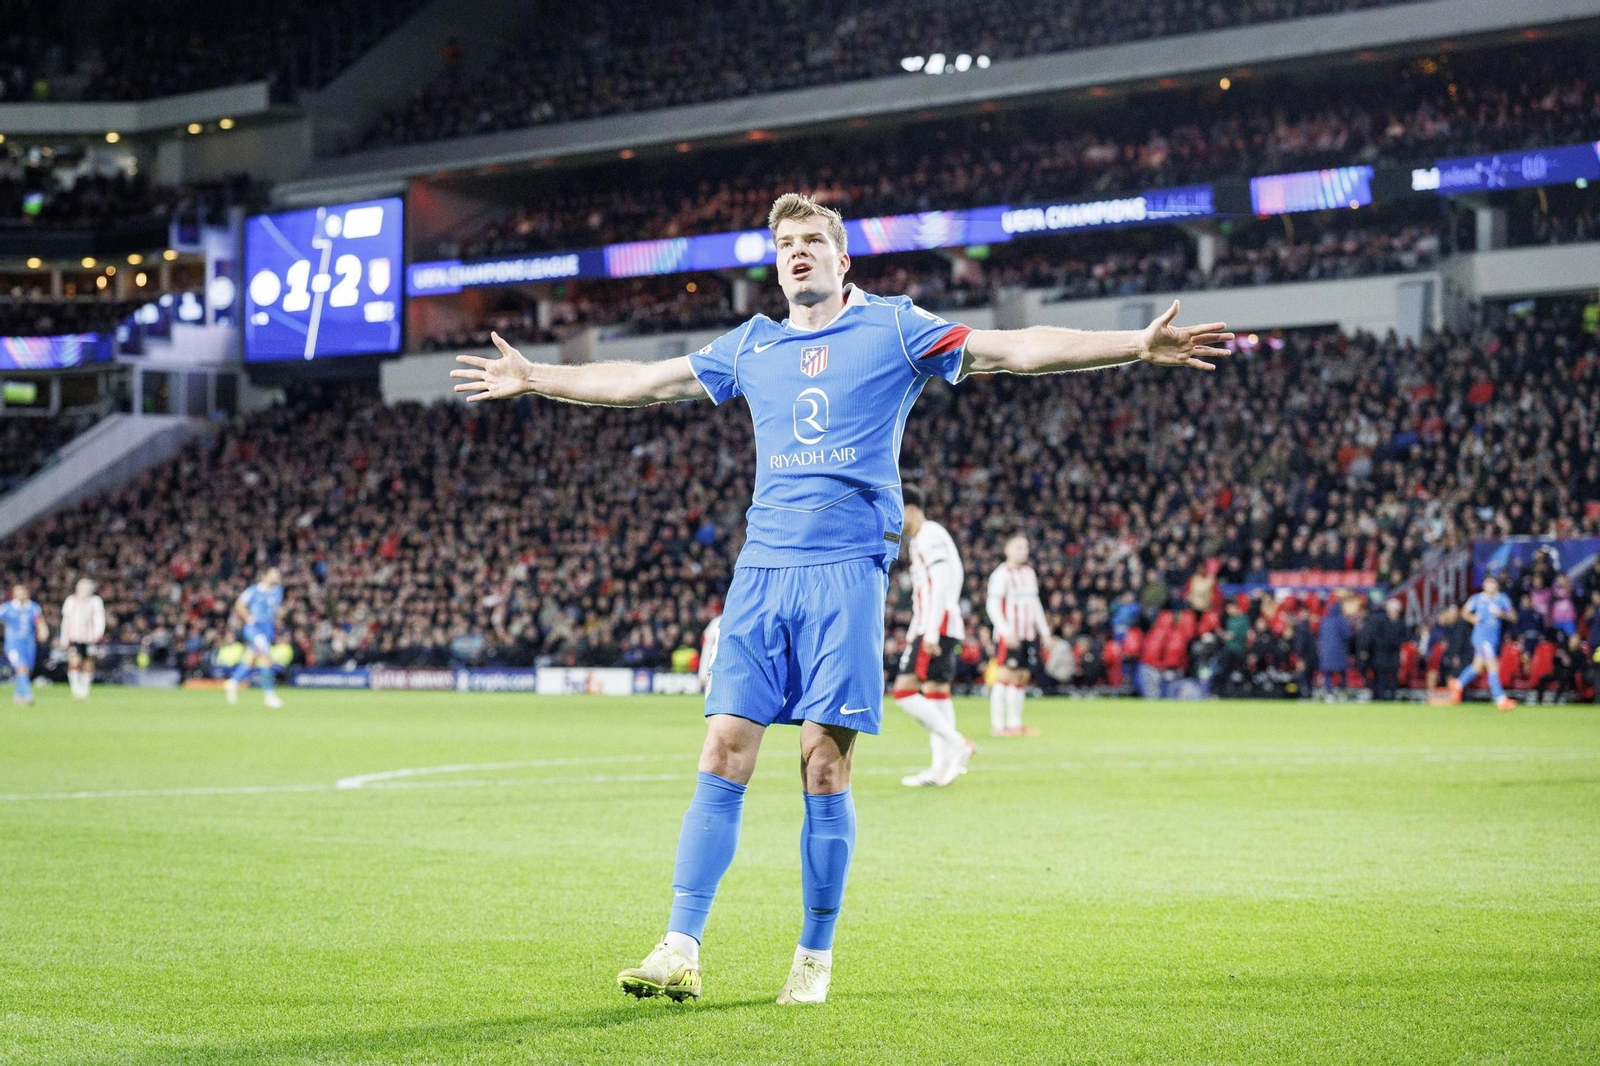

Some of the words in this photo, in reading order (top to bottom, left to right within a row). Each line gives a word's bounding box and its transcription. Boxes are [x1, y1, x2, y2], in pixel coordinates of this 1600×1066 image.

[1045, 196, 1147, 230] CHAMPIONS
[282, 259, 311, 312] 1
[329, 254, 362, 308] 2
[770, 450, 825, 469] RIYADH
[829, 447, 857, 462] AIR
